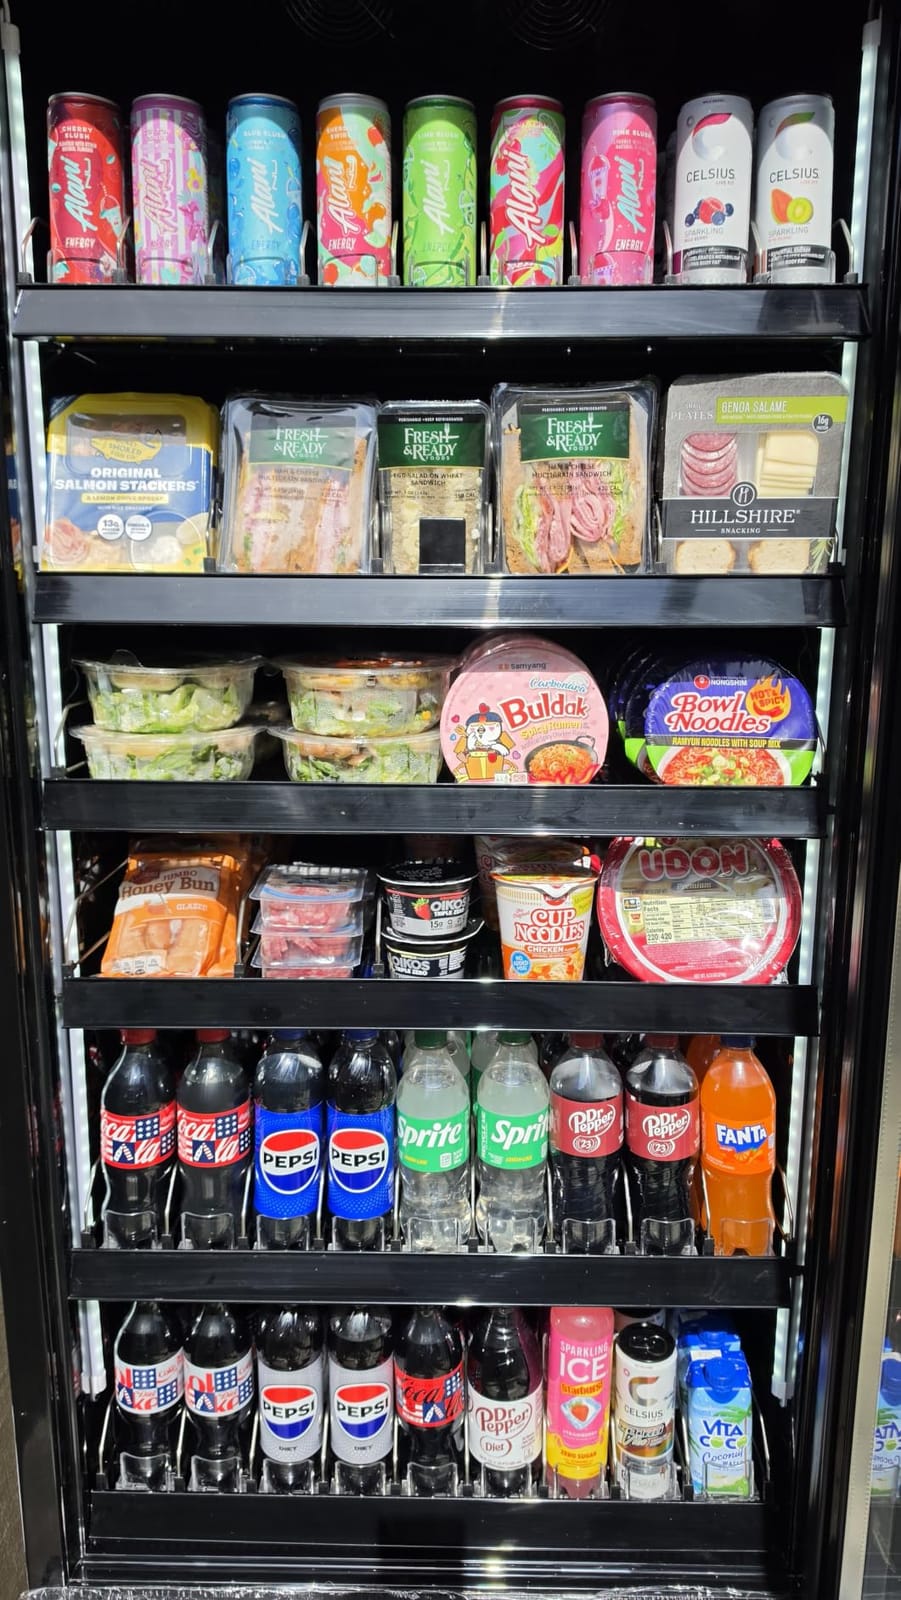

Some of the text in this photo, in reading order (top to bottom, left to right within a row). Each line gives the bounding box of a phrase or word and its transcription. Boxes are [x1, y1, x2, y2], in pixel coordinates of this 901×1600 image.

[62, 126, 93, 134] CHERRY
[686, 168, 736, 183] CELSIUS
[769, 168, 819, 183] CELSIUS
[60, 155, 98, 232] Alani
[246, 157, 284, 235] Alani
[323, 156, 361, 236] Alani
[420, 160, 455, 235] Alani
[503, 148, 546, 250] Alani
[614, 155, 646, 234] Alani
[684, 227, 724, 236] SPARKLING
[768, 226, 808, 236] SPARKLING
[65, 237, 96, 249] ENERGY
[328, 238, 357, 250] ENERGY
[615, 239, 644, 251] ENERGY
[721, 400, 788, 413] GENOA SALAME
[671, 411, 714, 421] PLATES
[817, 415, 829, 426] 16g
[547, 414, 603, 435] FRESH
[275, 428, 329, 441] FRESH
[404, 424, 460, 444] FRESH
[91, 467, 161, 479] ORIGINAL
[54, 480, 197, 492] SALMON STACKERS
[690, 509, 797, 524] HILLSHIRE
[529, 677, 588, 694] Carbonara
[750, 689, 772, 700] HOT
[759, 695, 786, 707] SPICY
[671, 693, 742, 714] Bowl
[499, 692, 590, 731] Buldak
[665, 712, 770, 732] Noodles
[519, 725, 548, 741] Spicy
[548, 719, 582, 731] Ramen
[672, 737, 781, 748] RAMYUN NOODLES WITH SOUP MIX
[639, 844, 749, 882] UDON
[163, 870, 198, 881] JUMBO
[121, 877, 215, 900] Honey Bun
[430, 897, 467, 912] OIKOS
[430, 920, 443, 929] 15g
[530, 908, 577, 927] CUP
[514, 920, 585, 945] NOODLES
[660, 932, 672, 940] 420
[527, 945, 564, 953] CHICKEN
[391, 956, 431, 971] OIKOS
[586, 1108, 604, 1121] Dr
[659, 1113, 678, 1125] Dr
[573, 1110, 614, 1135] Pepper
[647, 1114, 688, 1138] Pepper
[397, 1115, 463, 1149] Sprite
[490, 1114, 548, 1150] Sprit
[716, 1124, 767, 1145] FANTA
[580, 1140, 592, 1149] 23
[655, 1143, 668, 1153] 23
[263, 1148, 318, 1168] PEPSI
[332, 1148, 386, 1167] PEPSI
[560, 1341, 608, 1357] SPARKLING
[559, 1354, 608, 1382] ICE
[263, 1397, 315, 1419] PEPSI
[336, 1397, 389, 1418] PEPSI
[494, 1407, 515, 1418] Dr
[624, 1404, 664, 1419] CELSIUS
[479, 1406, 529, 1436] Pepper
[703, 1419, 744, 1437] VITA
[485, 1442, 504, 1452] Diet
[560, 1449, 597, 1459] ZERO SUGAR
[702, 1450, 744, 1464] Coconut
